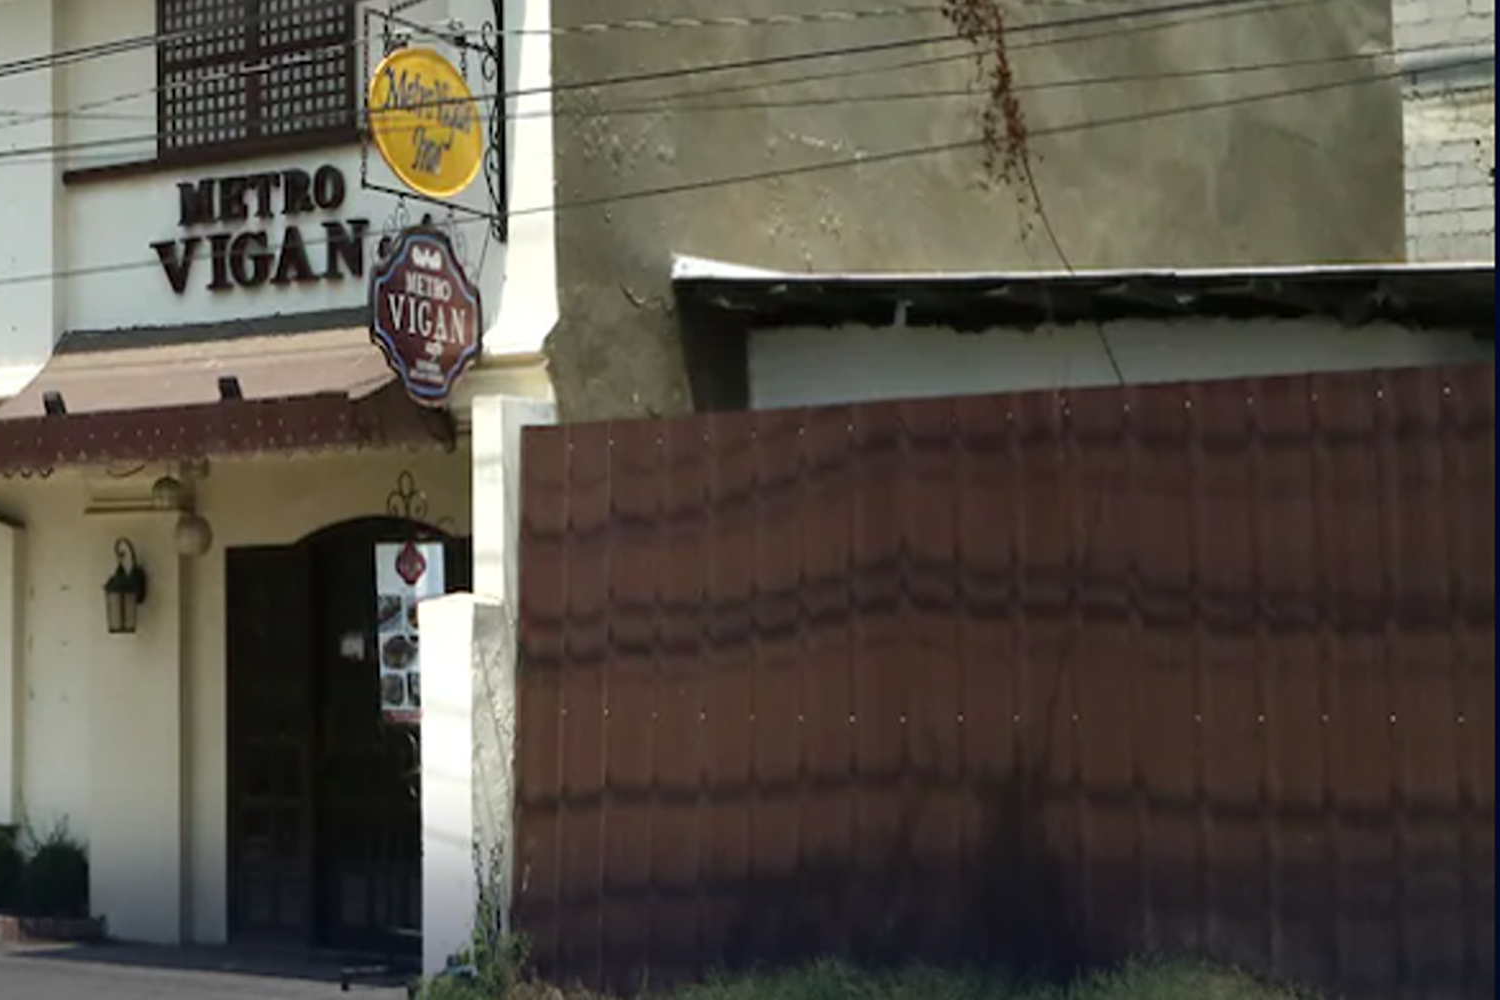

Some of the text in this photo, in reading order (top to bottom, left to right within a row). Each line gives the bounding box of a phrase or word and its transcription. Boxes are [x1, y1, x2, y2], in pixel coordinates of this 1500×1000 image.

[176, 164, 346, 226] METRO
[150, 218, 370, 295] VIGAN
[404, 270, 451, 301] METRO
[388, 293, 466, 345] VIGAN
